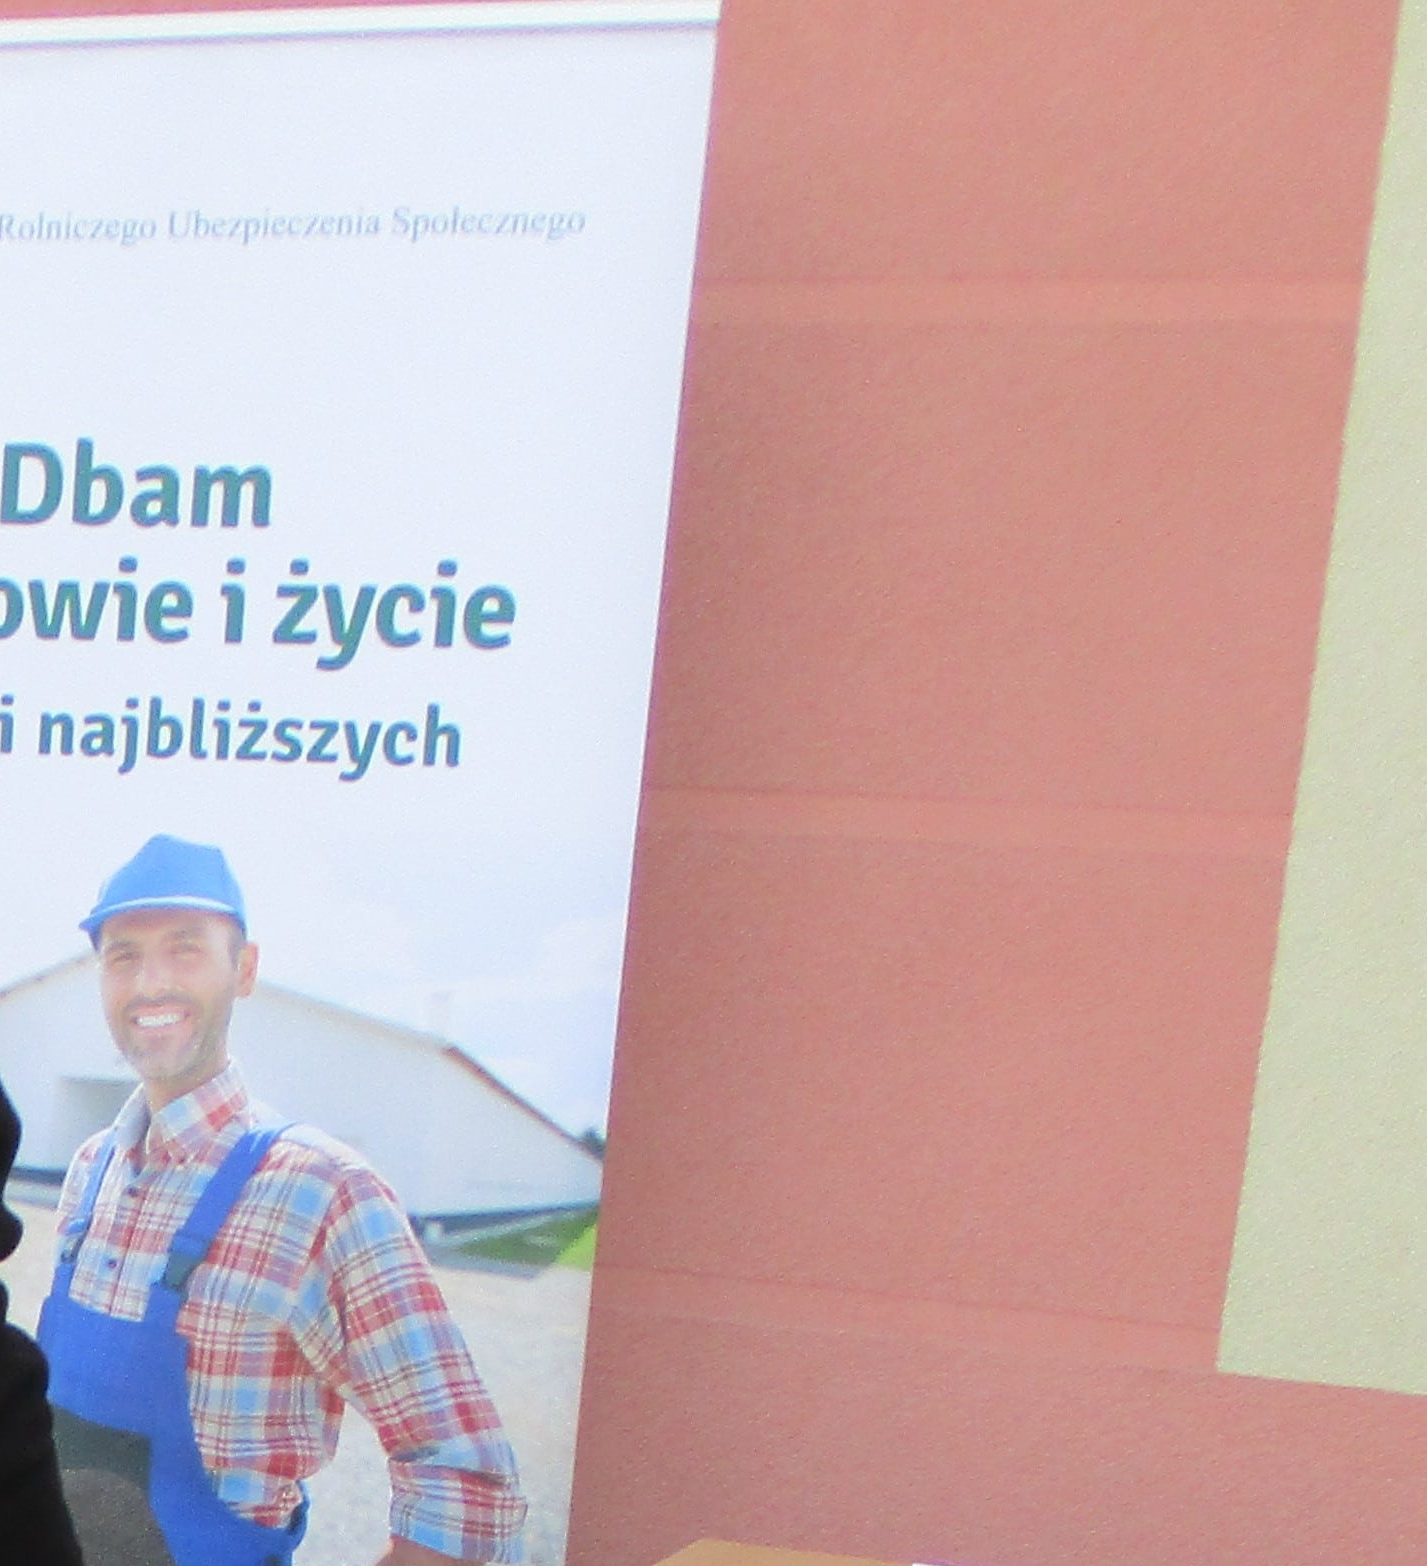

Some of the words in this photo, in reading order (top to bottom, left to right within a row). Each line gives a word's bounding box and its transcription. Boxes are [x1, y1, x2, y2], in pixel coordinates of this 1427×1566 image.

[167, 207, 382, 246] Ubezpieczenia
[391, 204, 587, 243] Społecznego
[219, 557, 247, 645] i
[271, 558, 517, 671] życie
[37, 696, 463, 783] najbliższych
